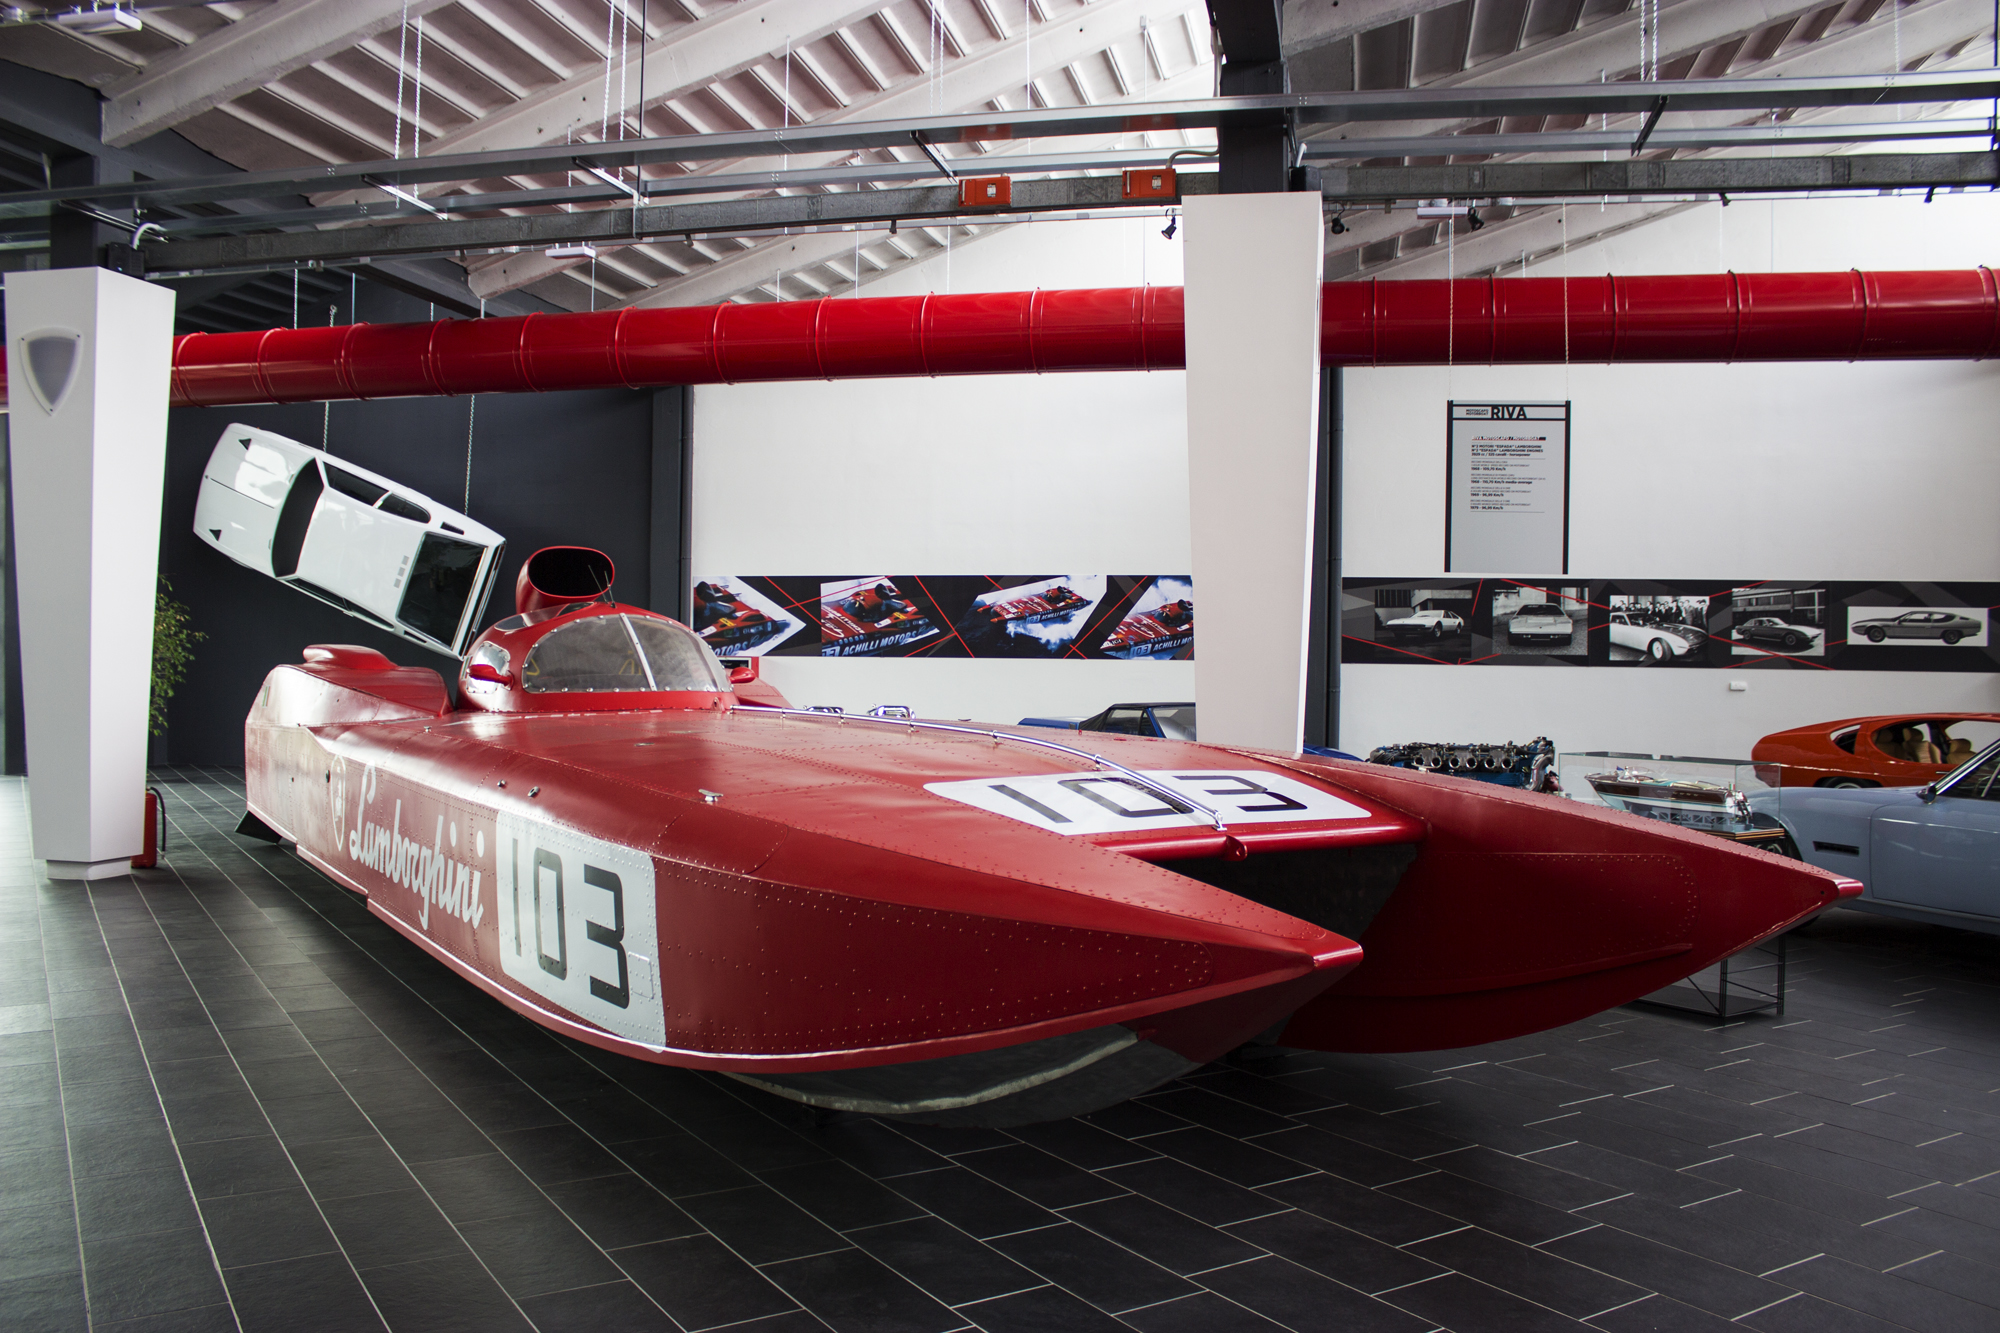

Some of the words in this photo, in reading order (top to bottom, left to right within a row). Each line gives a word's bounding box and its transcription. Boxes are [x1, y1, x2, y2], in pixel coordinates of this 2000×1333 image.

[1491, 406, 1527, 419] RIVA
[842, 640, 879, 656] ACHILLI
[880, 631, 917, 647] MOTORS
[1153, 639, 1181, 651] ACHILLI
[986, 775, 1308, 823] 103
[349, 761, 484, 930] Lamborghini
[512, 838, 630, 1009] 103
